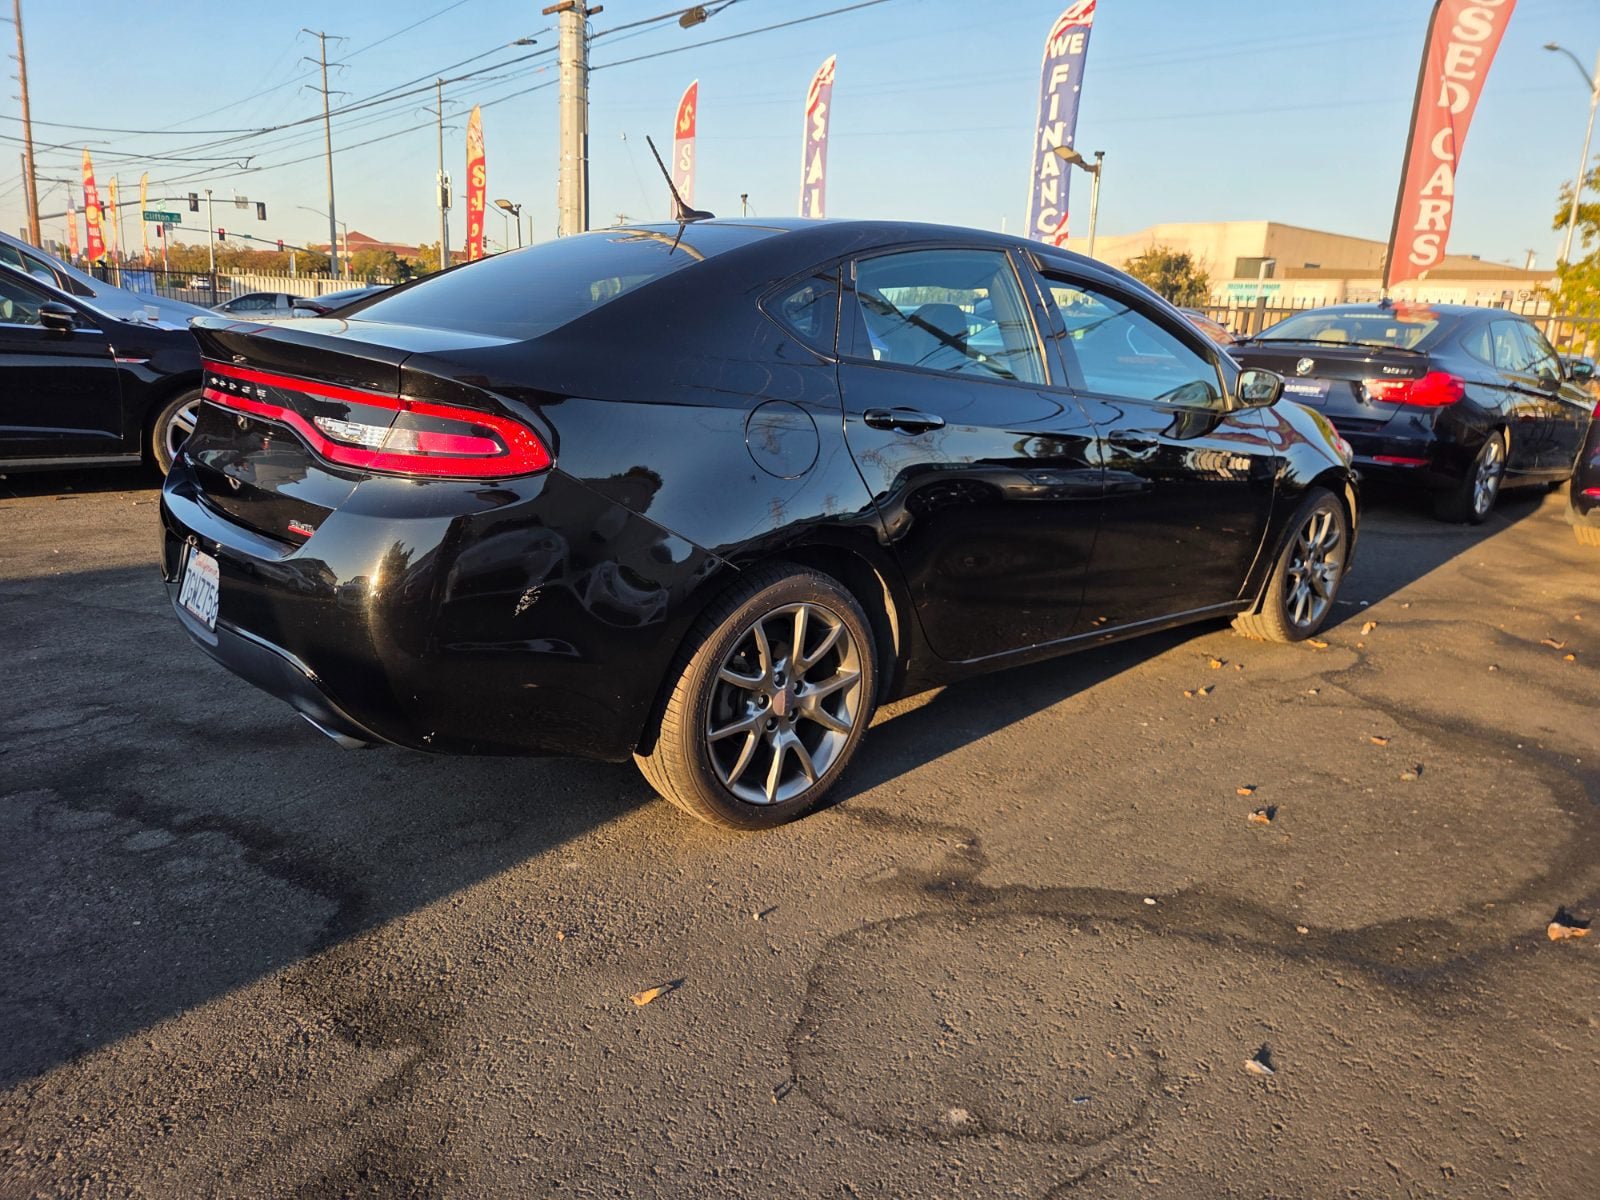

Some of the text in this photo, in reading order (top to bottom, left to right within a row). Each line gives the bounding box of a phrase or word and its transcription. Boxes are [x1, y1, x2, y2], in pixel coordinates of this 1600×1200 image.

[1050, 33, 1084, 58] WE
[1037, 64, 1069, 246] FINANC
[1409, 0, 1503, 266] SED CARS
[144, 212, 170, 222] Clifton
